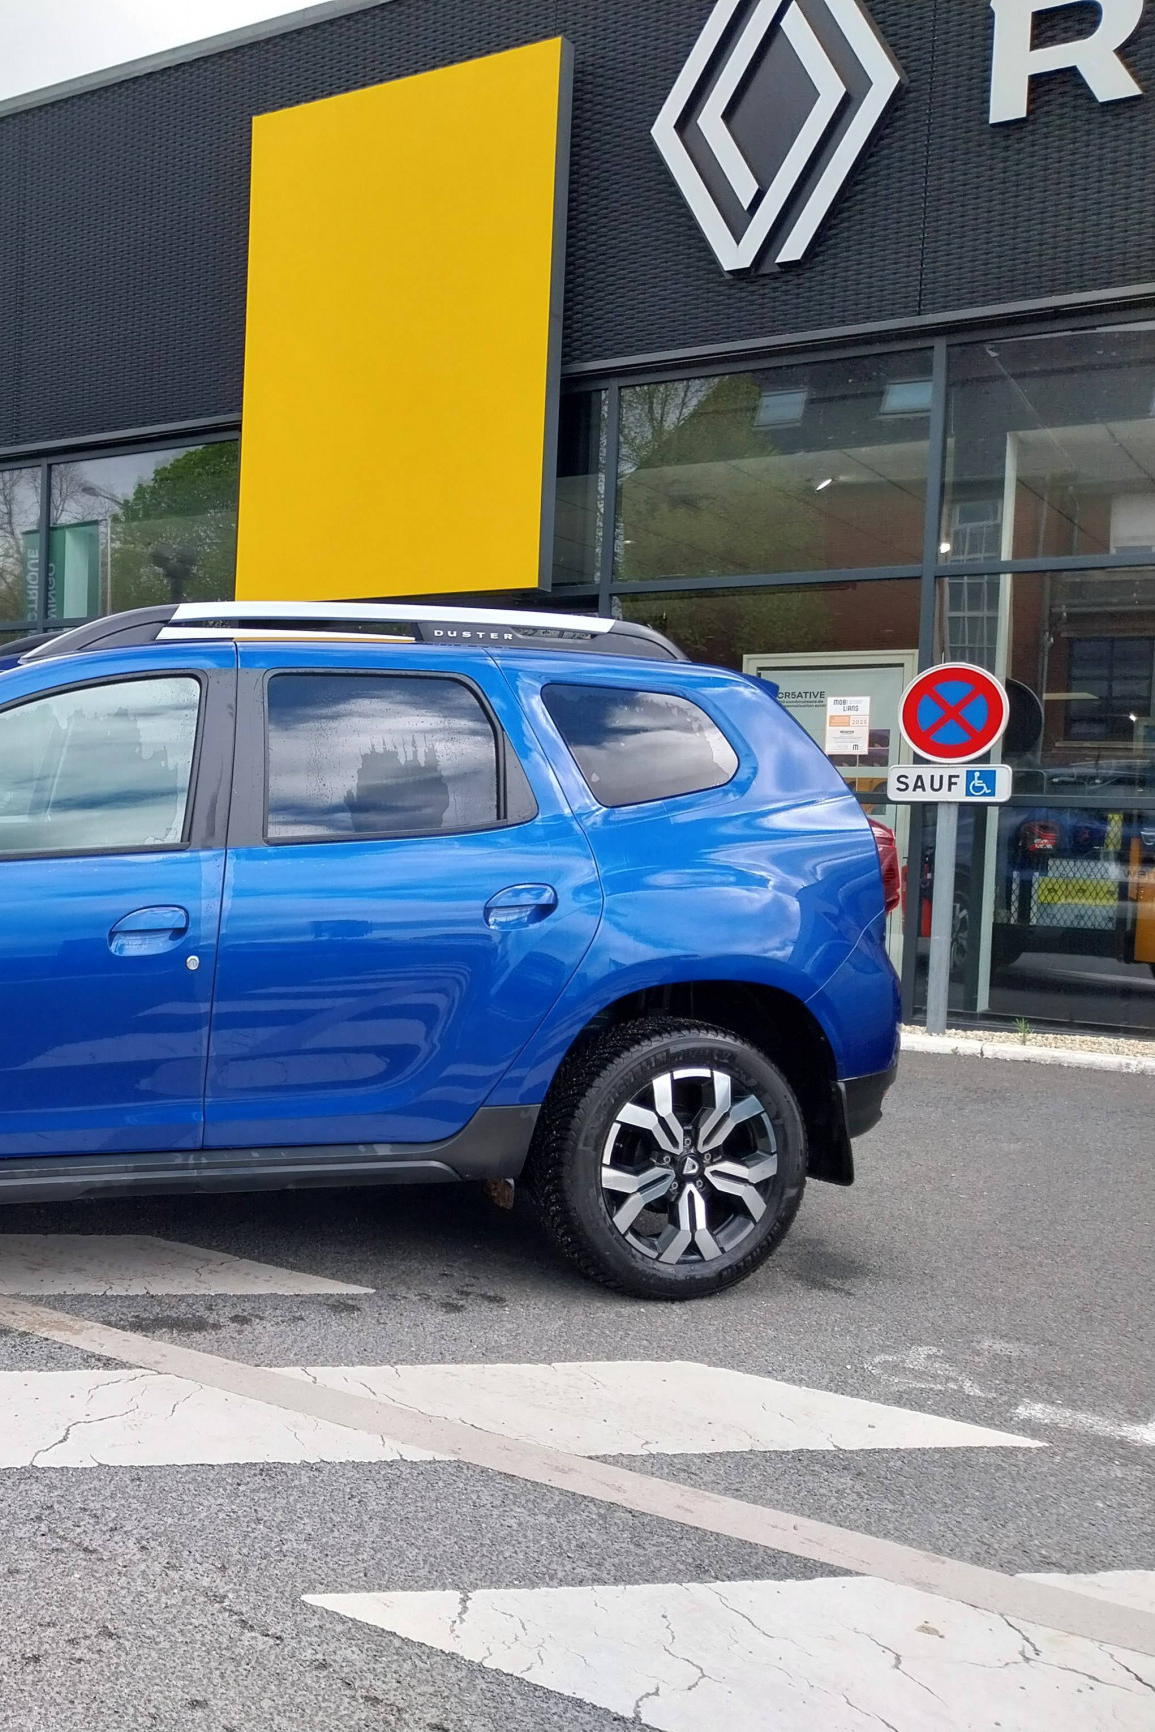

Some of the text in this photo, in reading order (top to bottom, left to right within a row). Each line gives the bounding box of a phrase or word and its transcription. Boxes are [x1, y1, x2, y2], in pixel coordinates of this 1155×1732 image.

[989, 0, 1144, 126] R
[433, 629, 513, 640] DUSTER
[896, 774, 960, 792] SAUF
